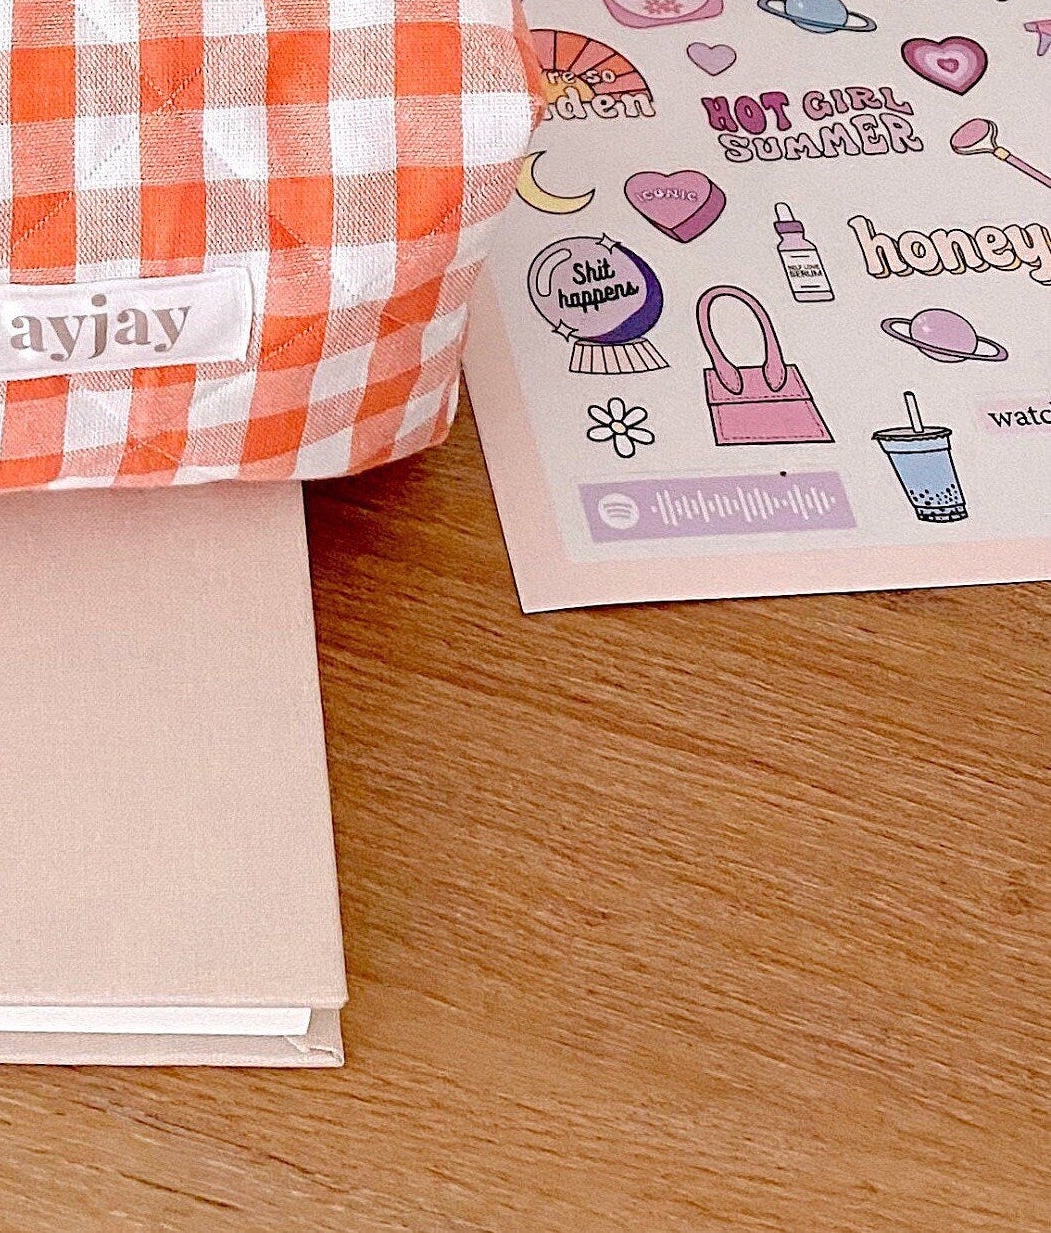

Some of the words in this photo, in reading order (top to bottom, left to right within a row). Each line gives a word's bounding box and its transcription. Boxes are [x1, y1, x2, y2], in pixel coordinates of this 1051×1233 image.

[543, 86, 657, 121] den
[700, 91, 792, 135] HOT
[802, 86, 915, 121] GIRL
[718, 113, 925, 163] SUMMER
[635, 187, 699, 203] ICONIC
[572, 257, 616, 285] Shit
[847, 214, 1051, 286] honey
[557, 280, 640, 313] happens
[10, 293, 193, 362] ayjay
